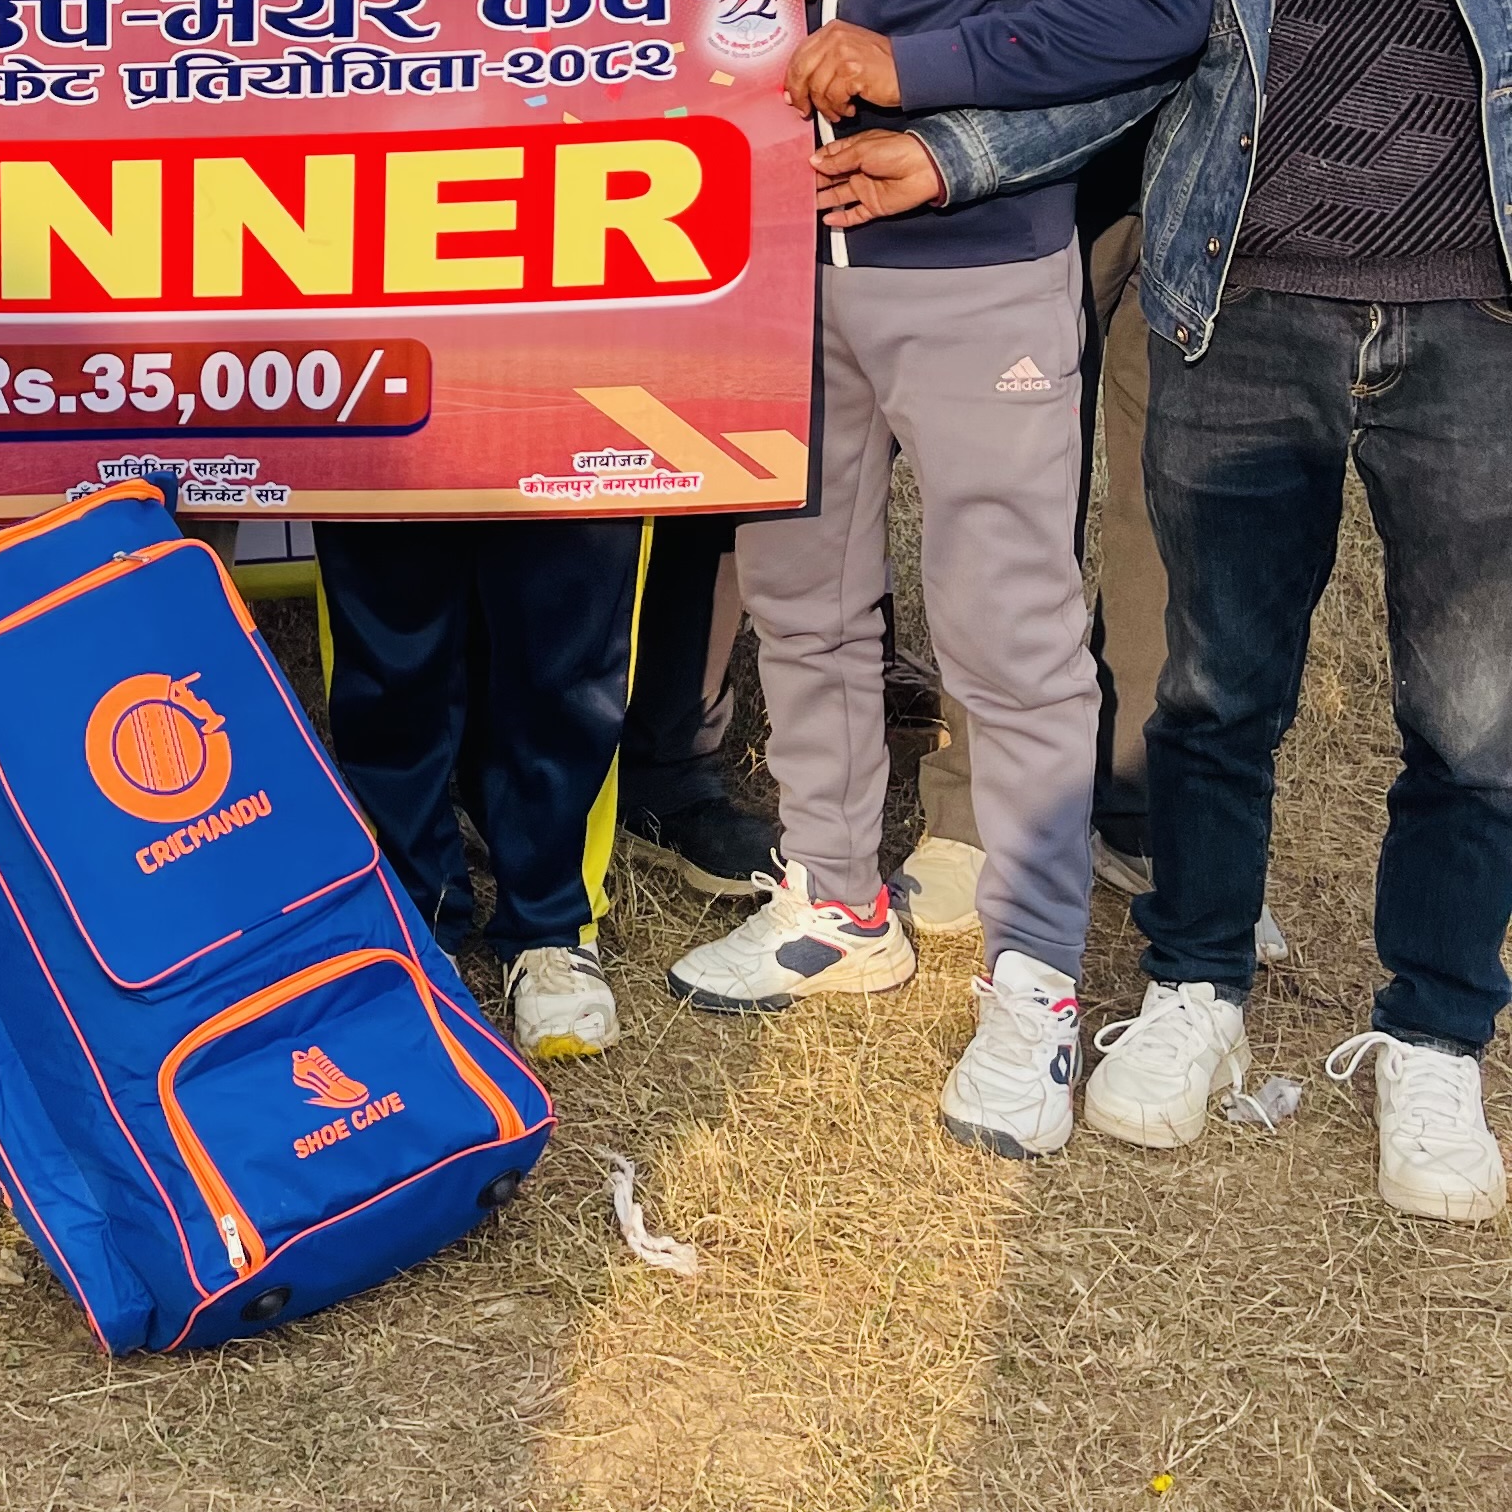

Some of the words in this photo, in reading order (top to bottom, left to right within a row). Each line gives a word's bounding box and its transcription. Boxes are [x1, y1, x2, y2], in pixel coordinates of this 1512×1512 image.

[995, 377, 1052, 392] adidas
[193, 459, 256, 478] सहयोग
[576, 452, 650, 469] आयोजक
[187, 483, 247, 503] क्रिकेट
[255, 484, 287, 503] संघ
[524, 476, 595, 498] कोहलपुर
[602, 472, 700, 492] नगरपालिका
[135, 789, 272, 875] CRICMANDU
[293, 1117, 352, 1159] SHOE
[351, 1091, 406, 1131] CAVE
